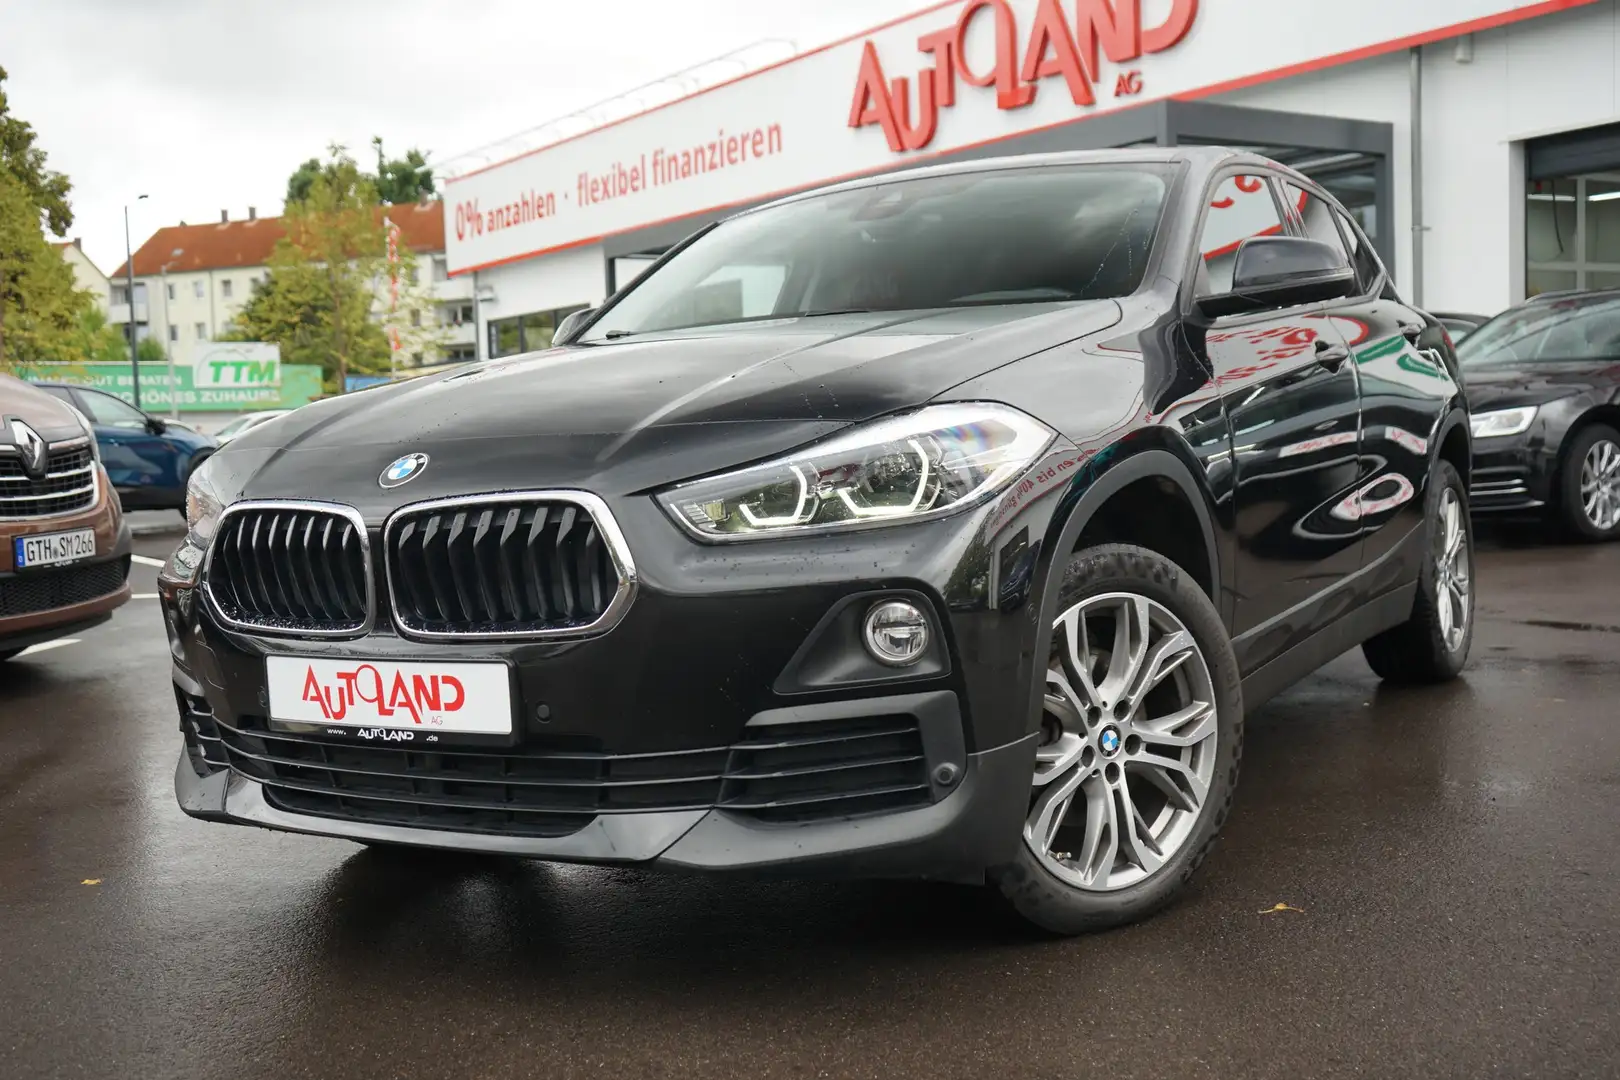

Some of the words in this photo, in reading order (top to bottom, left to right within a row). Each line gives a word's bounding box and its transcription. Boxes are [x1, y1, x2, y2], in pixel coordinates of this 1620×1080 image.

[1114, 70, 1144, 97] AG
[455, 197, 484, 242] 0%
[487, 189, 557, 234] anzahlen
[577, 154, 647, 208] flexibel
[652, 122, 784, 187] finanzieren
[209, 360, 276, 383] TTM
[26, 539, 52, 562] GTH
[302, 664, 465, 724] AUTOLAND
[431, 715, 444, 726] AG
[357, 727, 415, 742] AUTOLAND
